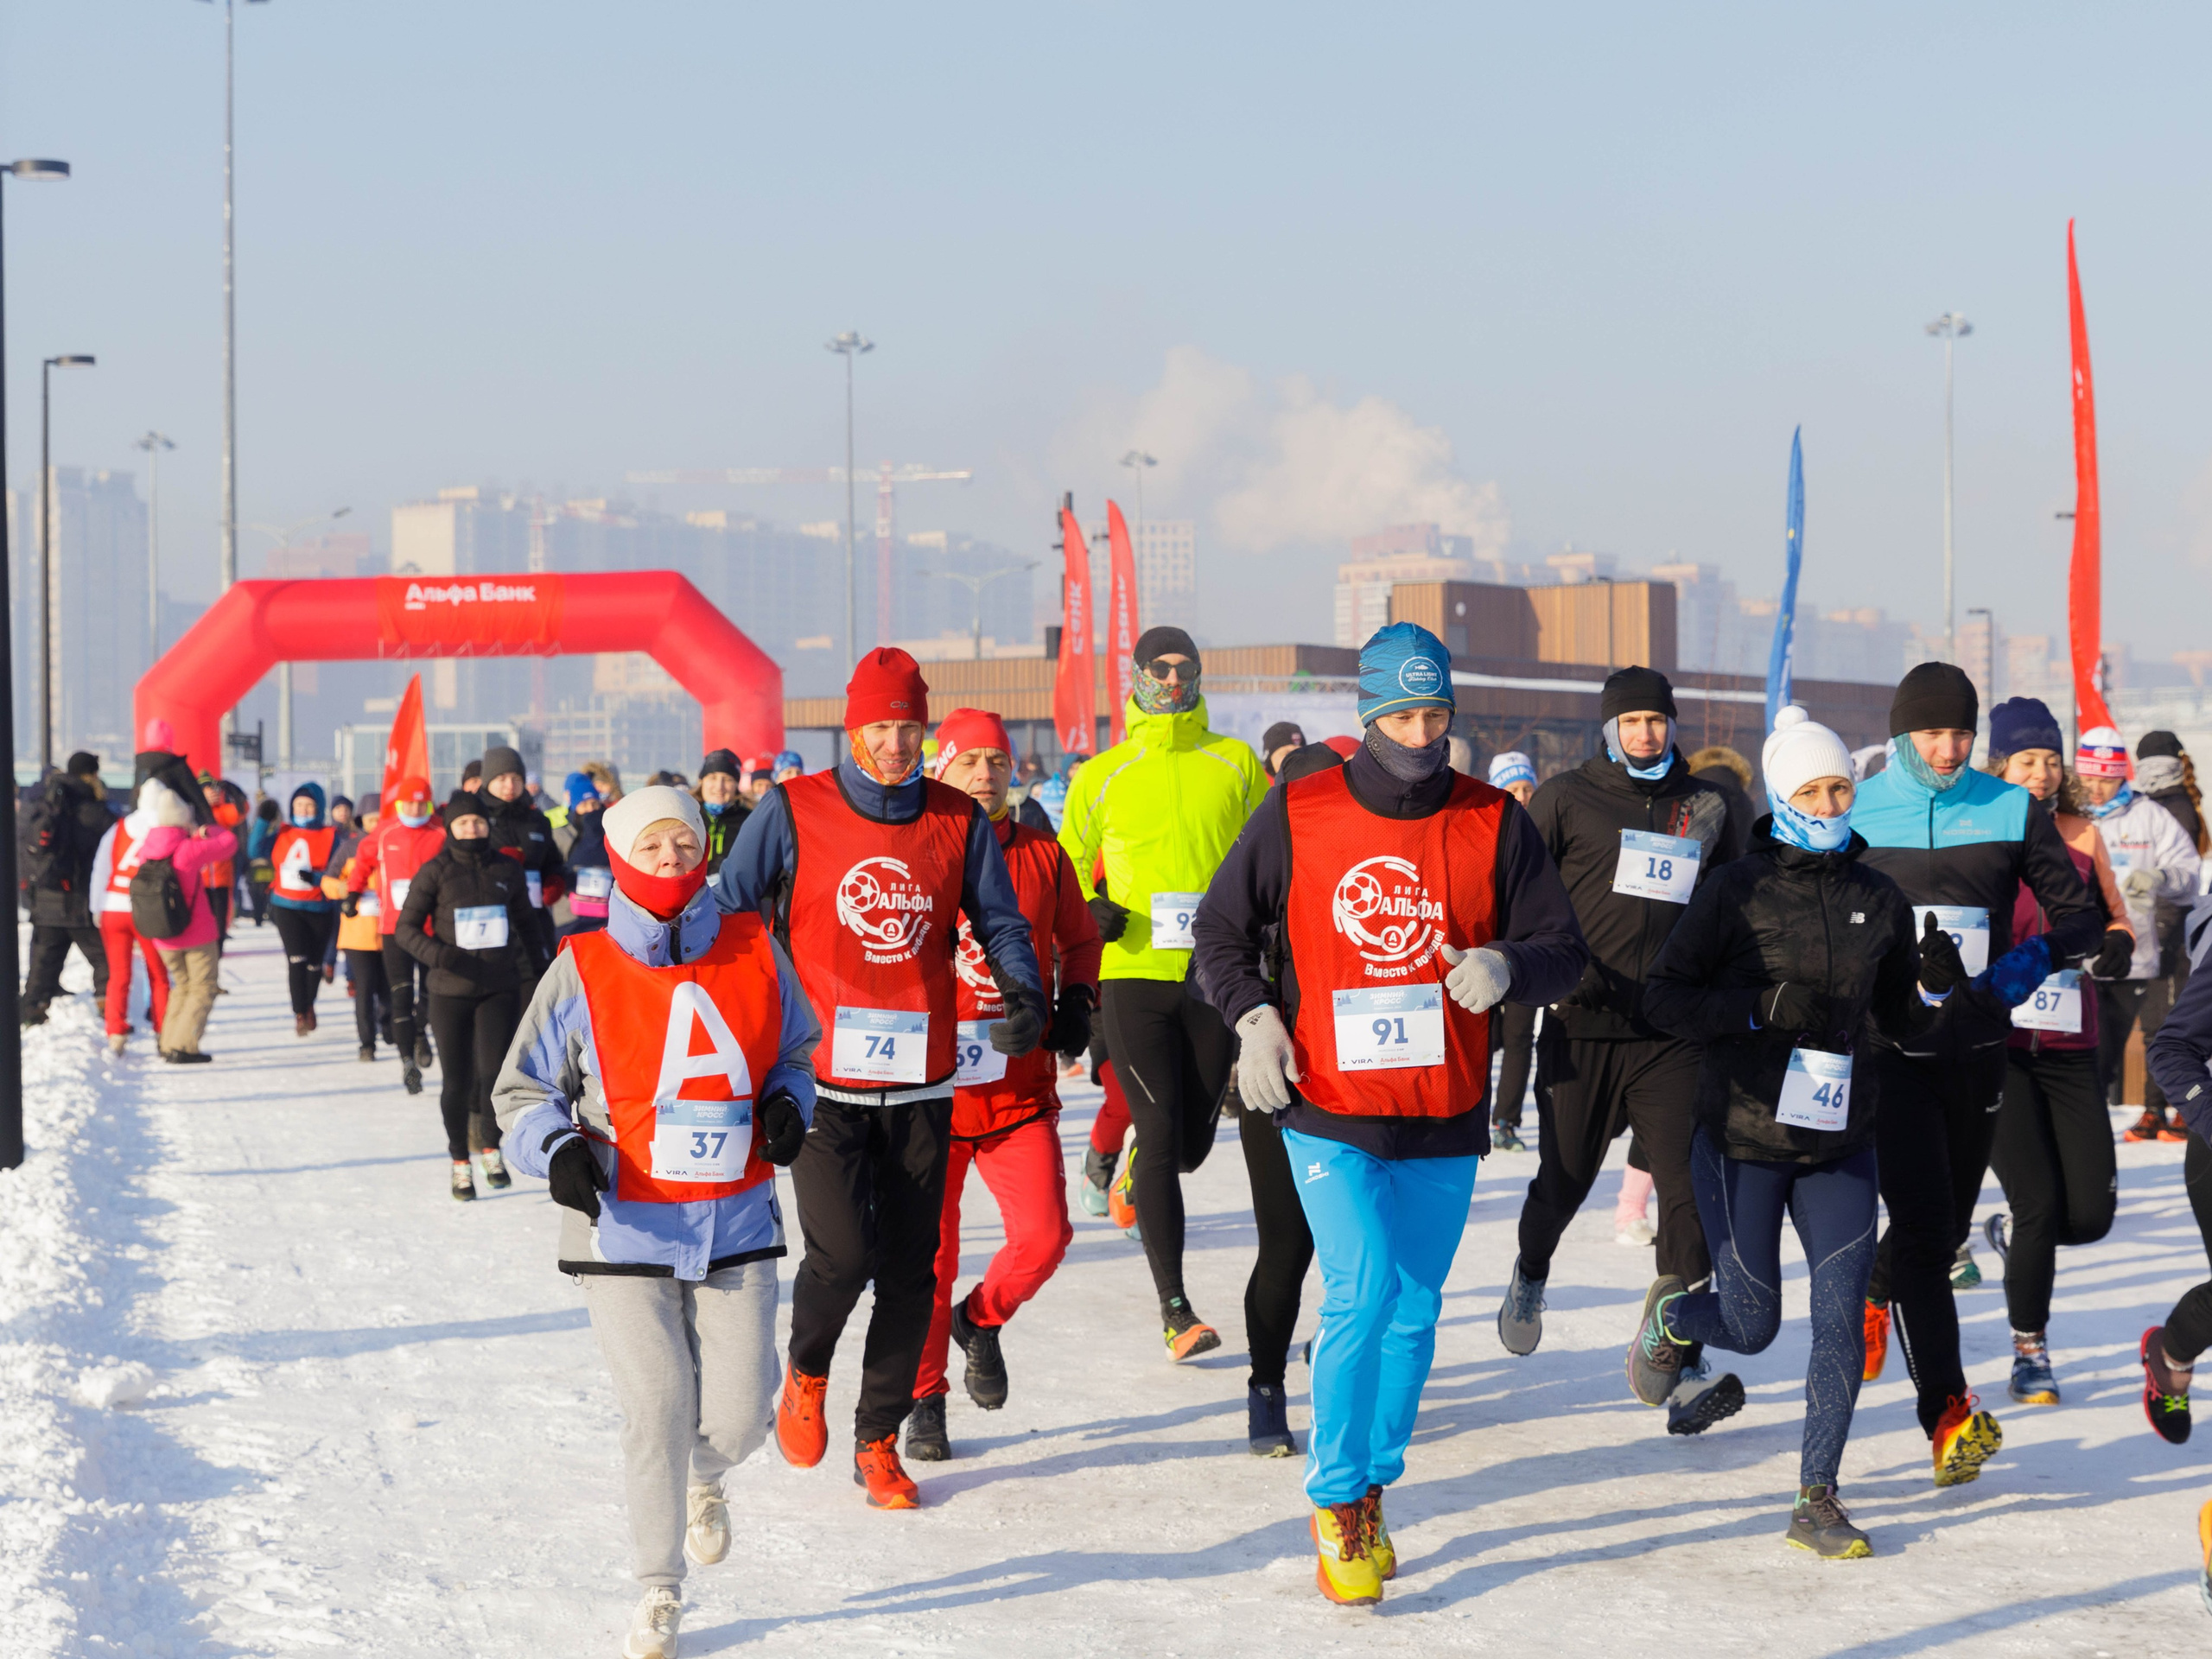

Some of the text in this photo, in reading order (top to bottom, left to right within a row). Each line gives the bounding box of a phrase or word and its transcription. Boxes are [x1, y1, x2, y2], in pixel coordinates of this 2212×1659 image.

[404, 582, 536, 607] Альфа Банк
[1645, 857, 1673, 881] 18
[890, 882, 921, 893] ЛИГА
[1393, 885, 1428, 898] ЛИГА
[877, 892, 933, 912] АЛЬФА
[1379, 896, 1444, 921] АЛЬФА
[479, 922, 486, 937] 7
[1176, 912, 1197, 931] 9
[864, 950, 904, 964] Вместе
[904, 950, 912, 960] к
[1364, 929, 1446, 978] Вместе к победе!
[1370, 989, 1406, 1000] ЗИМНИЙ
[2034, 990, 2062, 1012] 87
[1372, 1017, 1408, 1046] 91
[865, 1035, 895, 1059] 74
[1812, 1082, 1844, 1109] 46
[692, 1104, 728, 1113] ЗИМНИЙ
[690, 1131, 728, 1159] 37
